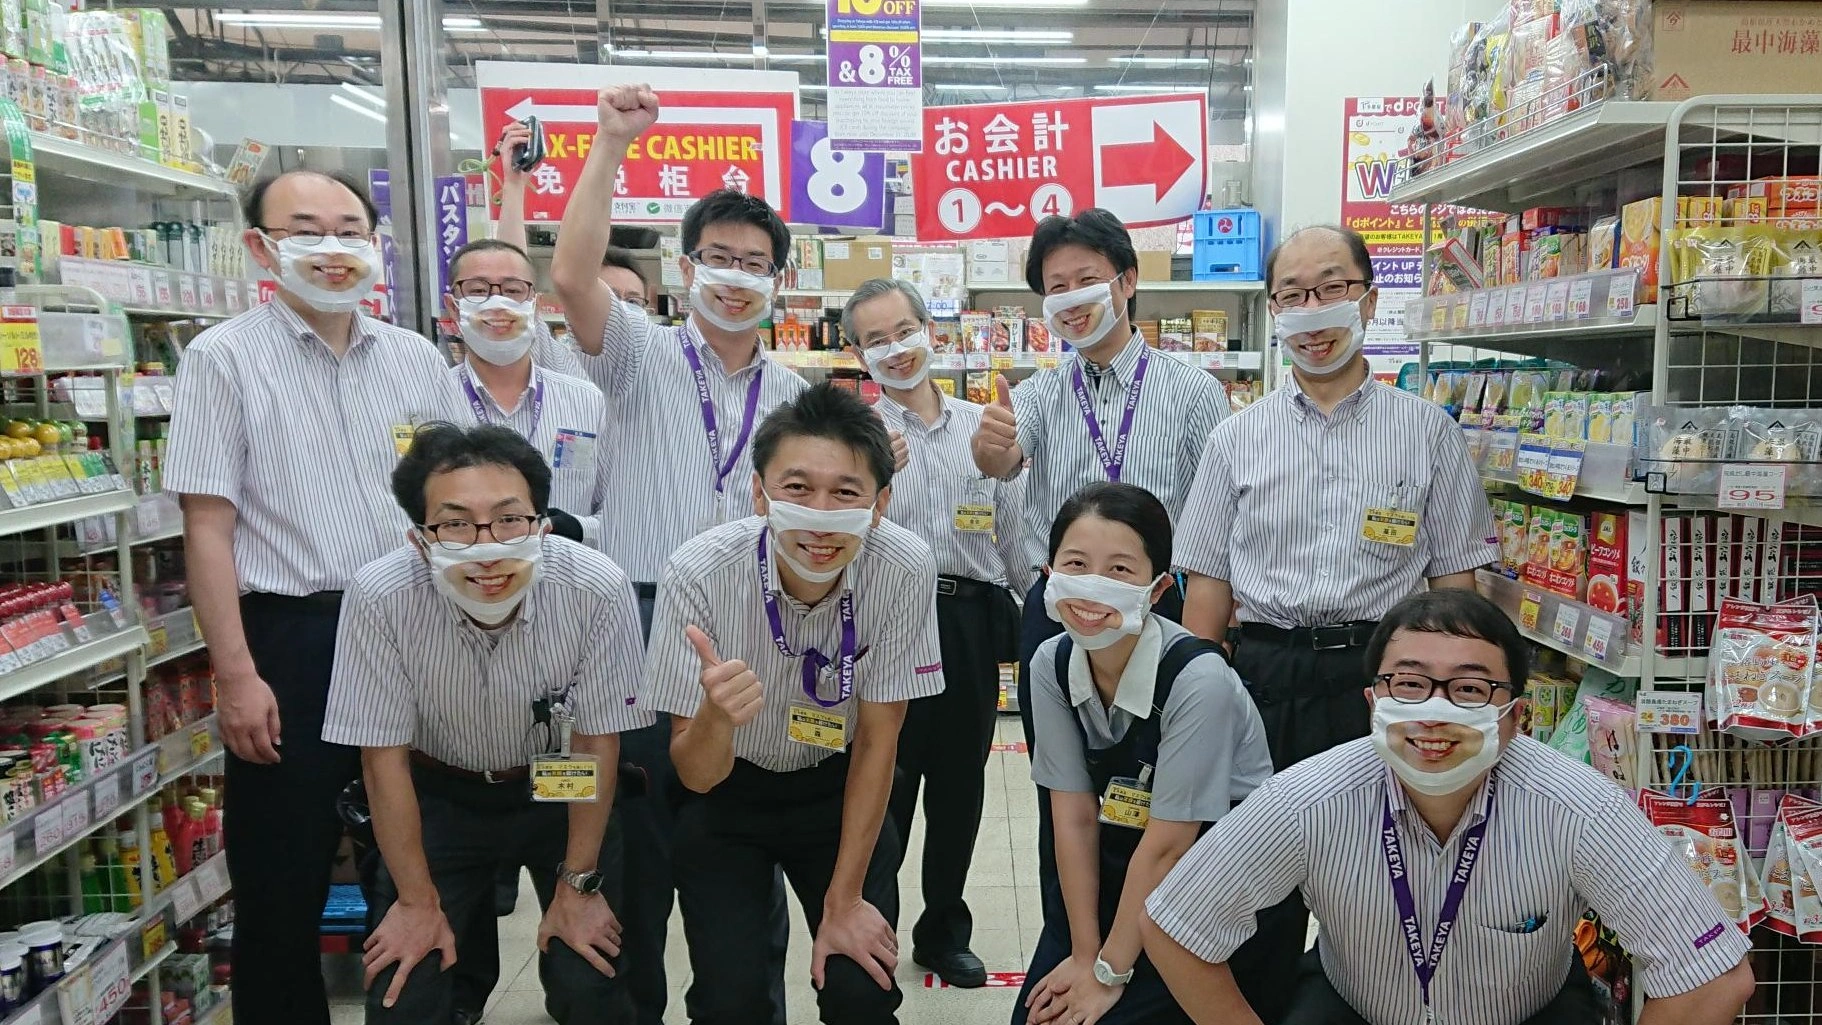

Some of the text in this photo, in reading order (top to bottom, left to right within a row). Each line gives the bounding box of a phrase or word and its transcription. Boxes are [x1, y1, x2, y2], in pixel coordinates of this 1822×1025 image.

[884, 0, 916, 15] OFF
[887, 76, 914, 85] FREE
[888, 67, 912, 77] TAX
[934, 108, 1070, 156] お会計
[646, 134, 760, 162] CASHIER
[945, 155, 1058, 182] CASHIER
[15, 347, 39, 367] 128
[1076, 387, 1092, 416] TAKEYA
[1127, 380, 1142, 411] TAKEYA
[1094, 437, 1112, 469] TAKEYA
[1113, 433, 1127, 467] TAKEYA
[1729, 489, 1775, 501] 95
[841, 654, 853, 699] TAKEYA
[1660, 713, 1690, 727] 380
[1383, 826, 1404, 880] TAKEYA
[1453, 835, 1480, 884] TAKEYA
[1404, 915, 1425, 968] TAKEYA
[1428, 920, 1451, 968] TAKEYA
[99, 977, 127, 1012] 450
